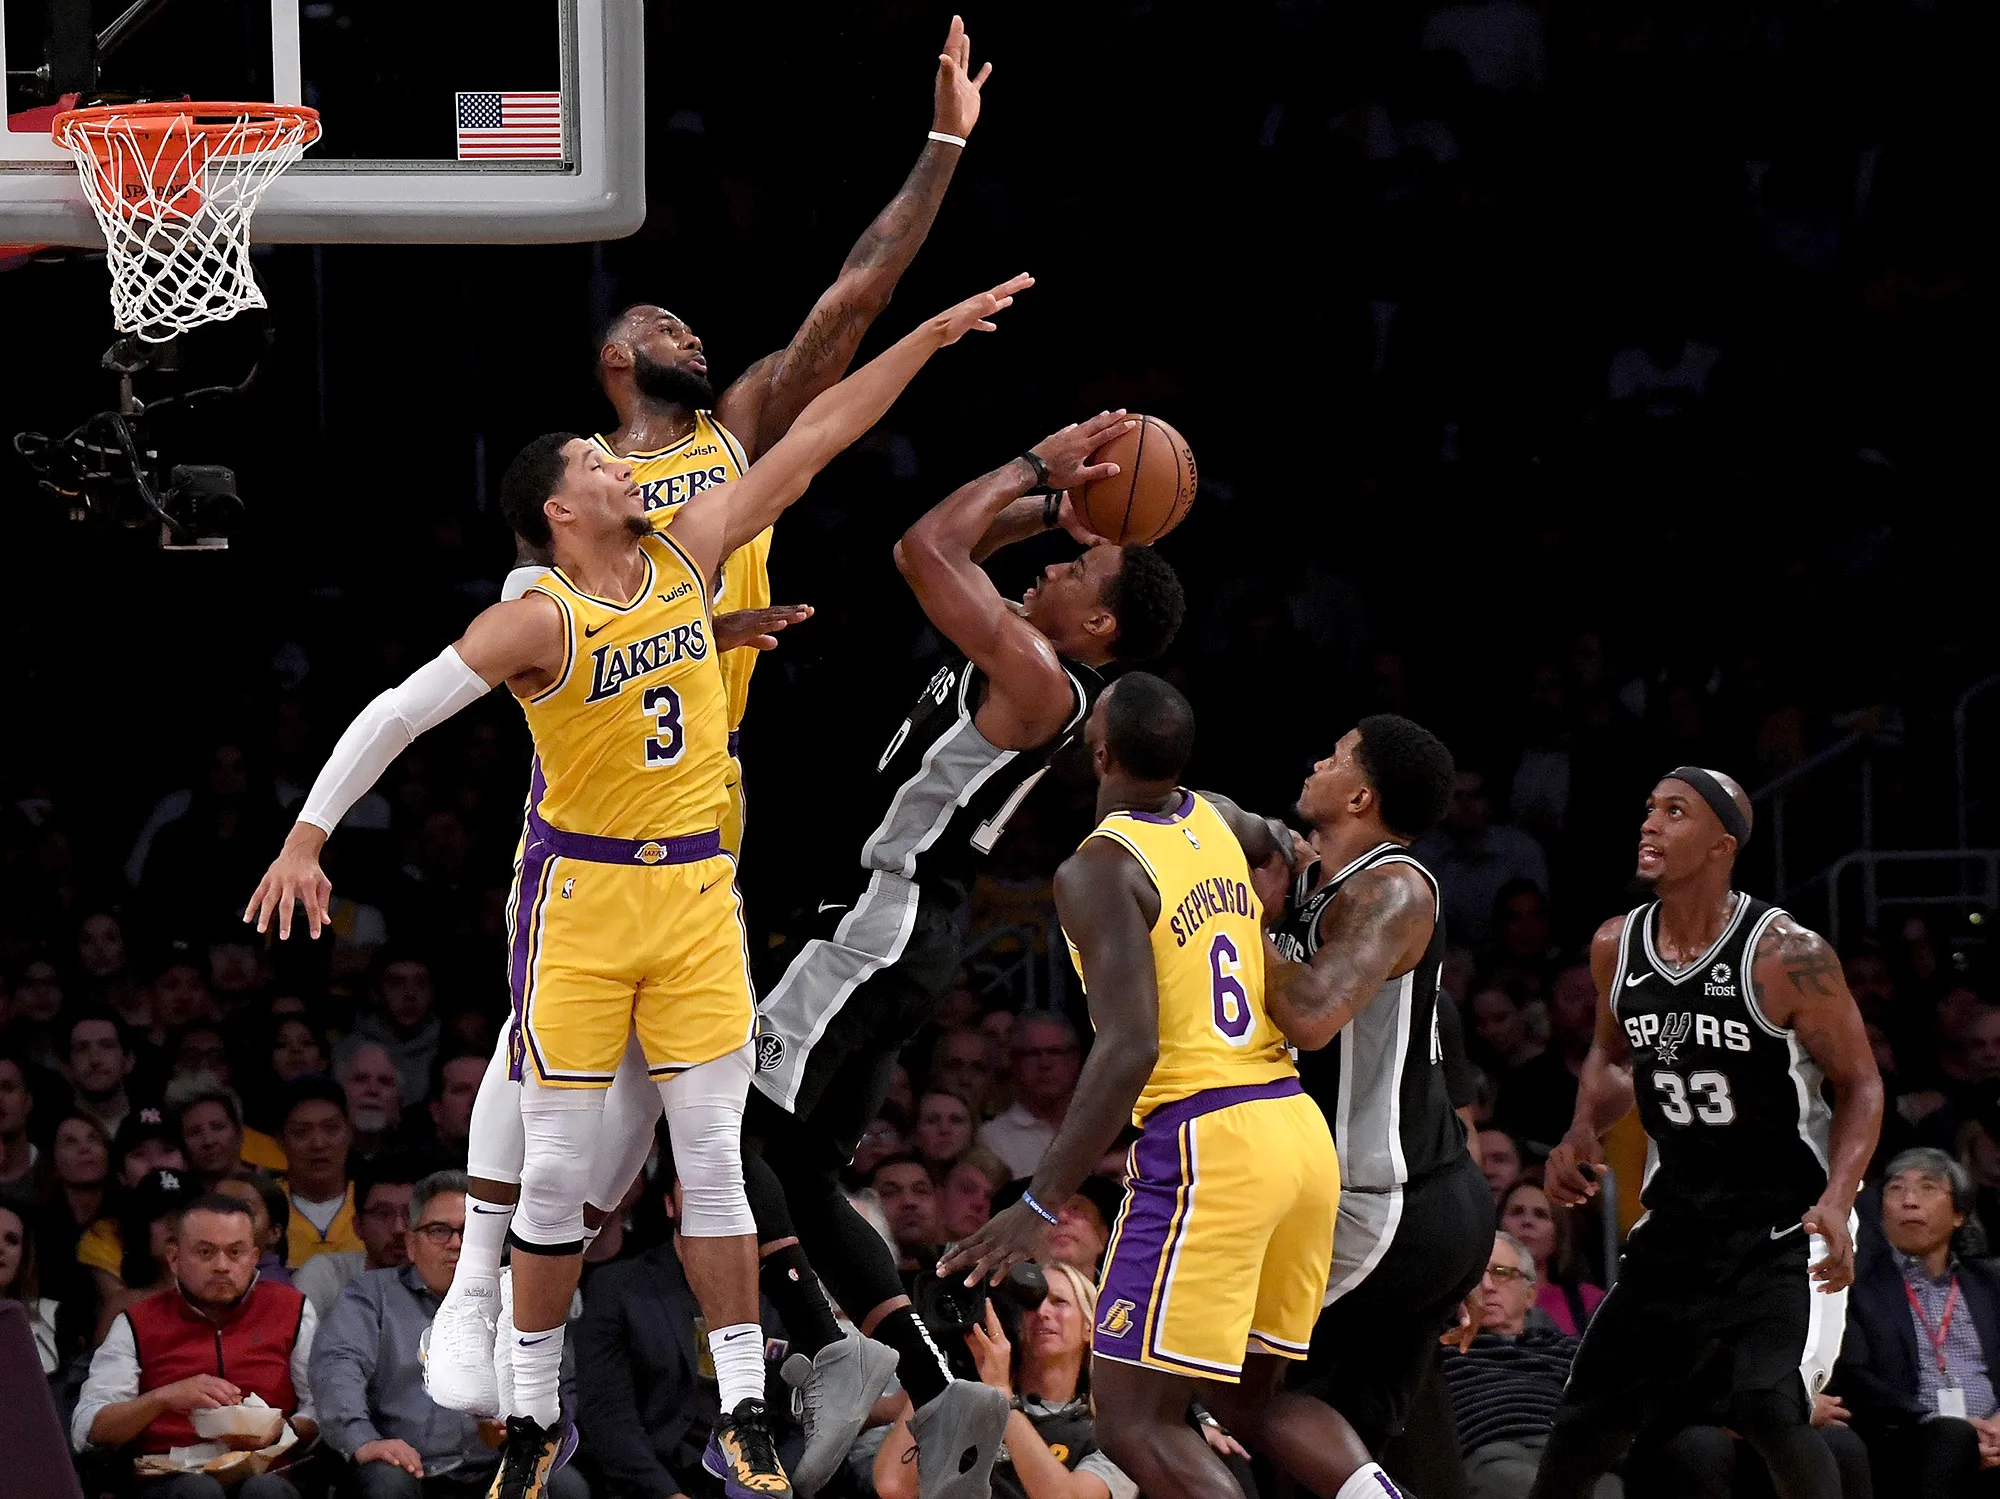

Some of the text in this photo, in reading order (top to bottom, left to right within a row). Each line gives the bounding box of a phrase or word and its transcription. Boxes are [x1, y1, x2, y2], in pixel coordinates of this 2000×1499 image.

[125, 183, 189, 199] SPADNG
[683, 445, 718, 459] wish
[639, 466, 727, 512] KERS
[657, 581, 693, 602] wish
[584, 620, 708, 704] LAKERS
[642, 685, 685, 766] 3
[876, 717, 912, 773] 0
[1170, 876, 1256, 948] STEPHENSO
[1209, 933, 1256, 1046] 6
[1704, 983, 1737, 997] Frost
[1624, 1012, 1751, 1064] SPURS
[1651, 1070, 1737, 1126] 33
